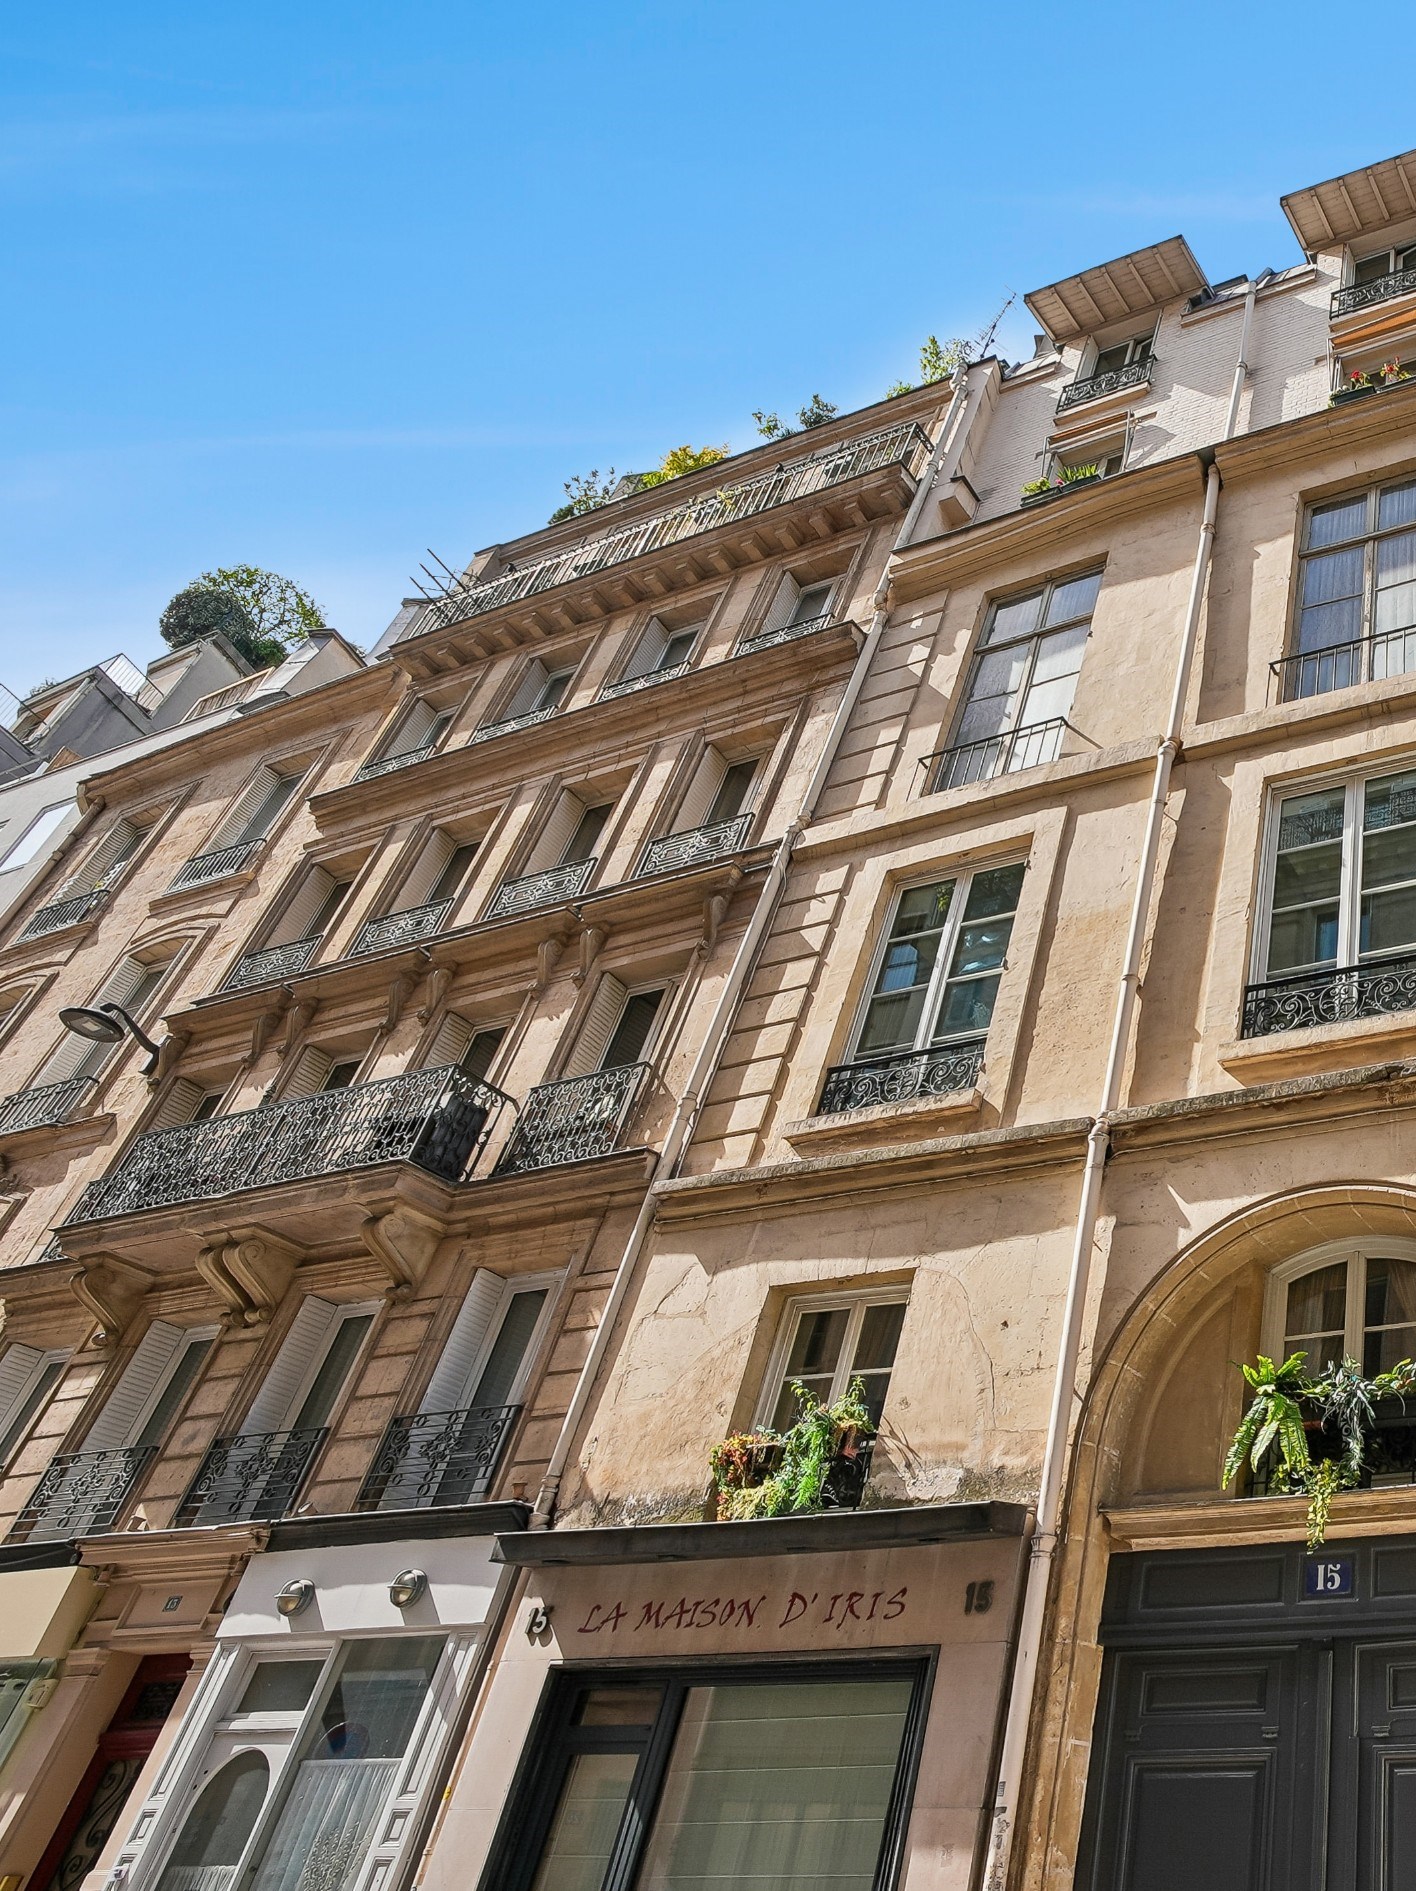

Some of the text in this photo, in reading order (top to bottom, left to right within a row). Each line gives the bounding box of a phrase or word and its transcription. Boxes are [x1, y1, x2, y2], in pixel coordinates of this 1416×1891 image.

[1316, 1563, 1341, 1590] 15
[577, 1587, 907, 1633] LA MAISON D'IRIS
[964, 1580, 994, 1615] 15
[525, 1607, 549, 1633] 15
